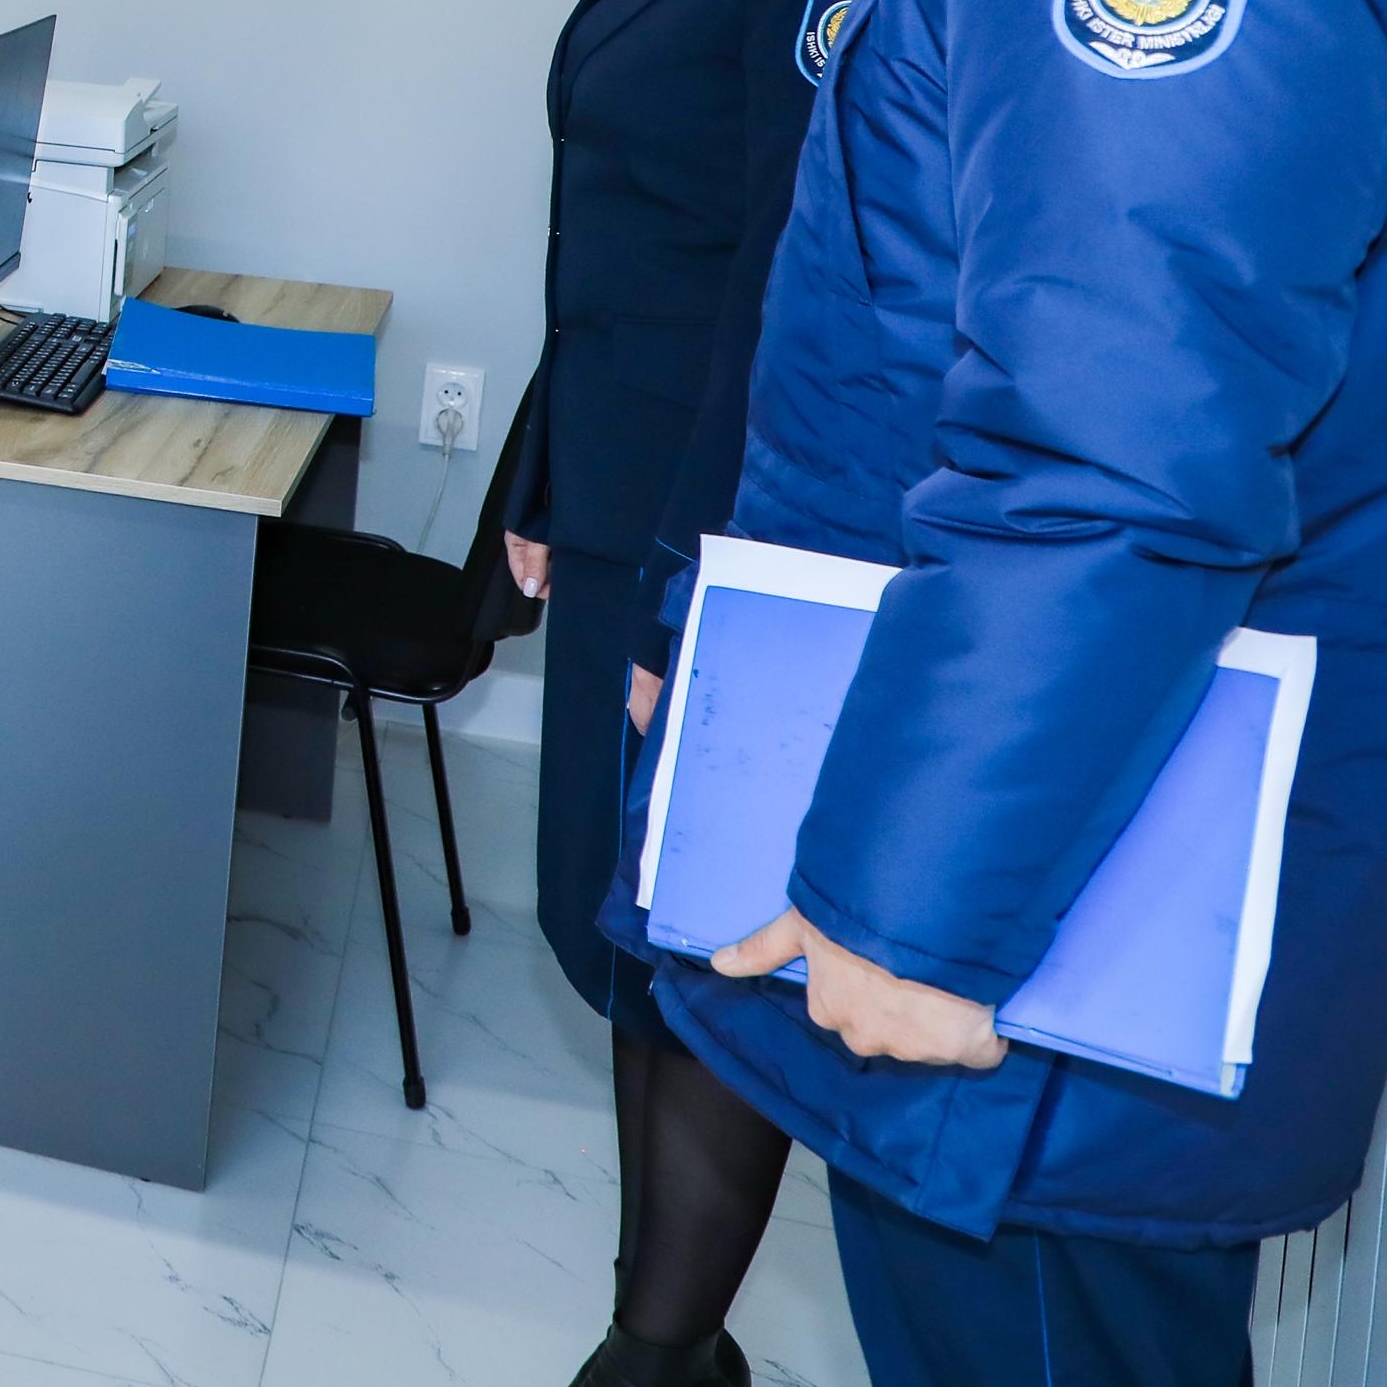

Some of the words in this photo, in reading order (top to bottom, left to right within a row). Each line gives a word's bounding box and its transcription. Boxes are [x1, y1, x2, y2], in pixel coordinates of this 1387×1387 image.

[1086, 17, 1136, 48] ISTER
[806, 31, 819, 59] ISHKI
[813, 56, 827, 69] IS
